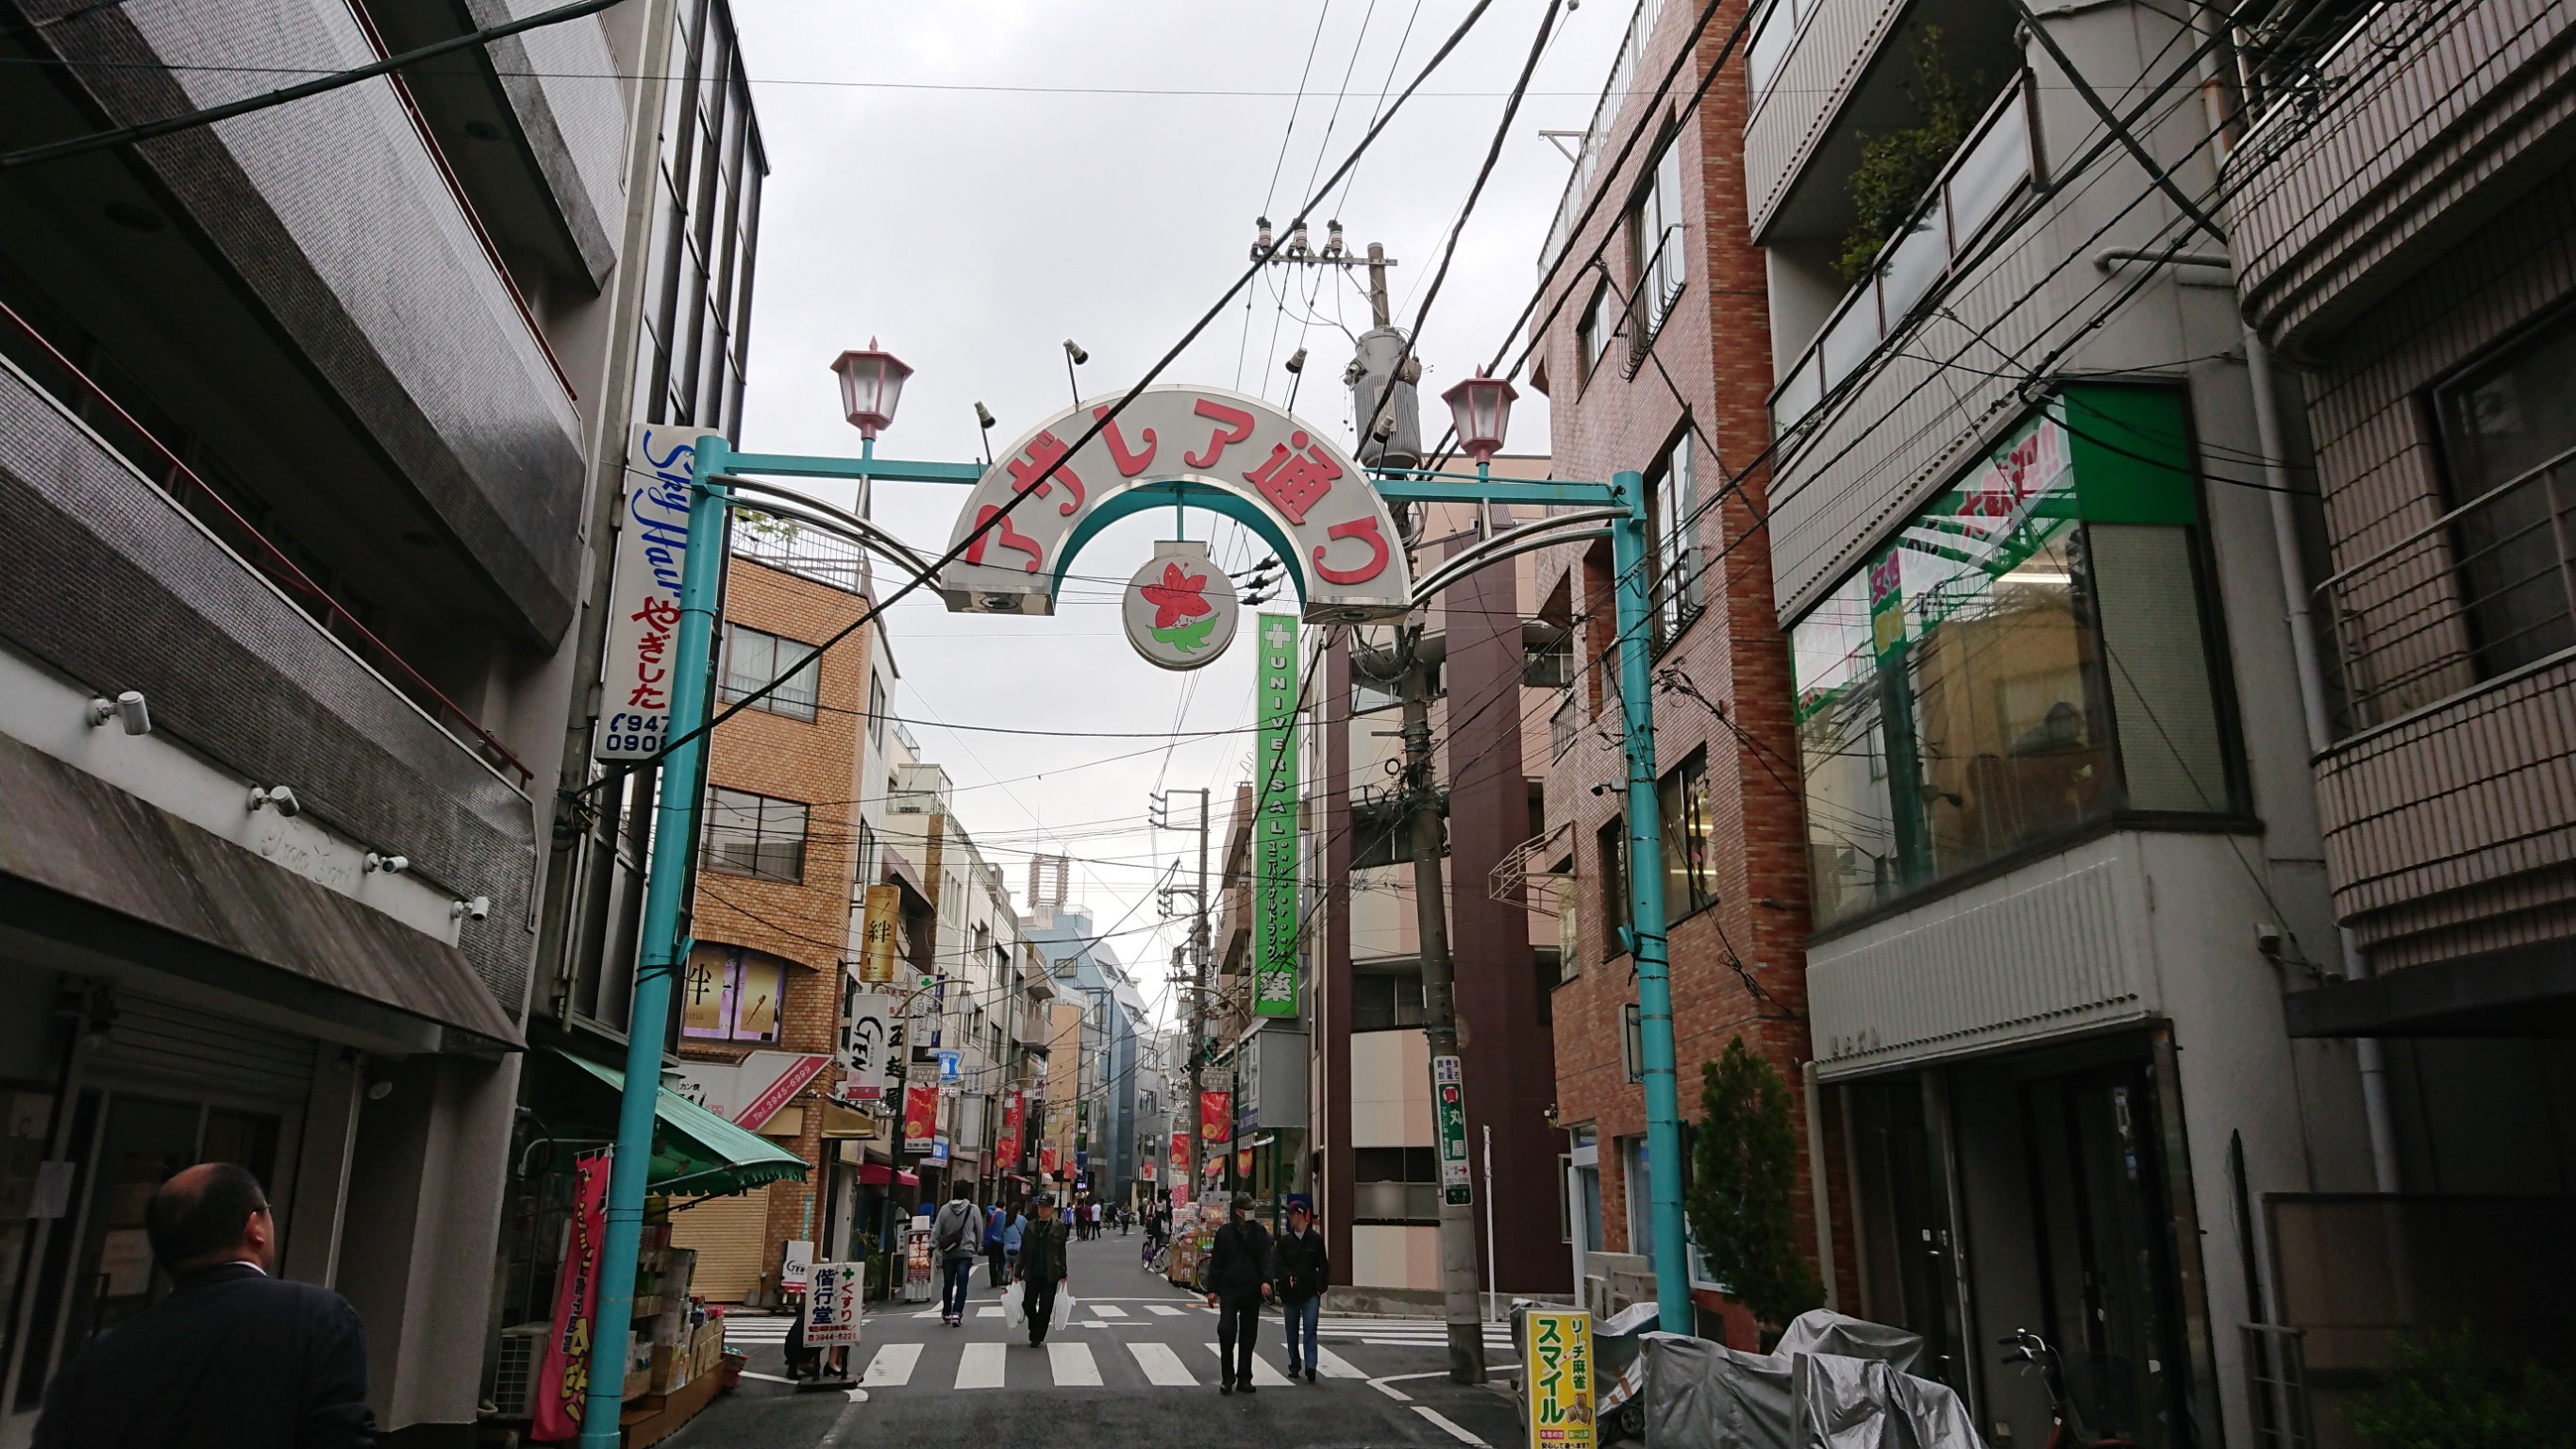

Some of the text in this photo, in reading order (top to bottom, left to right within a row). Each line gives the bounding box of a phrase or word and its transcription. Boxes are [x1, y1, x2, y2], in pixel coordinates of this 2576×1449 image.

[964, 398, 1390, 586] アザレア通り
[627, 596, 680, 709] やぎした
[1269, 656, 1287, 835] UNIVERSAL
[869, 920, 891, 943] 絆
[1259, 970, 1294, 1003] 薬
[752, 1065, 811, 1123] Tel.3945-6999
[812, 1268, 836, 1324] 偕行堂
[841, 1282, 855, 1323] くすり
[1538, 1319, 1565, 1424] スマイル
[1572, 1320, 1586, 1390] リーチ麻雀
